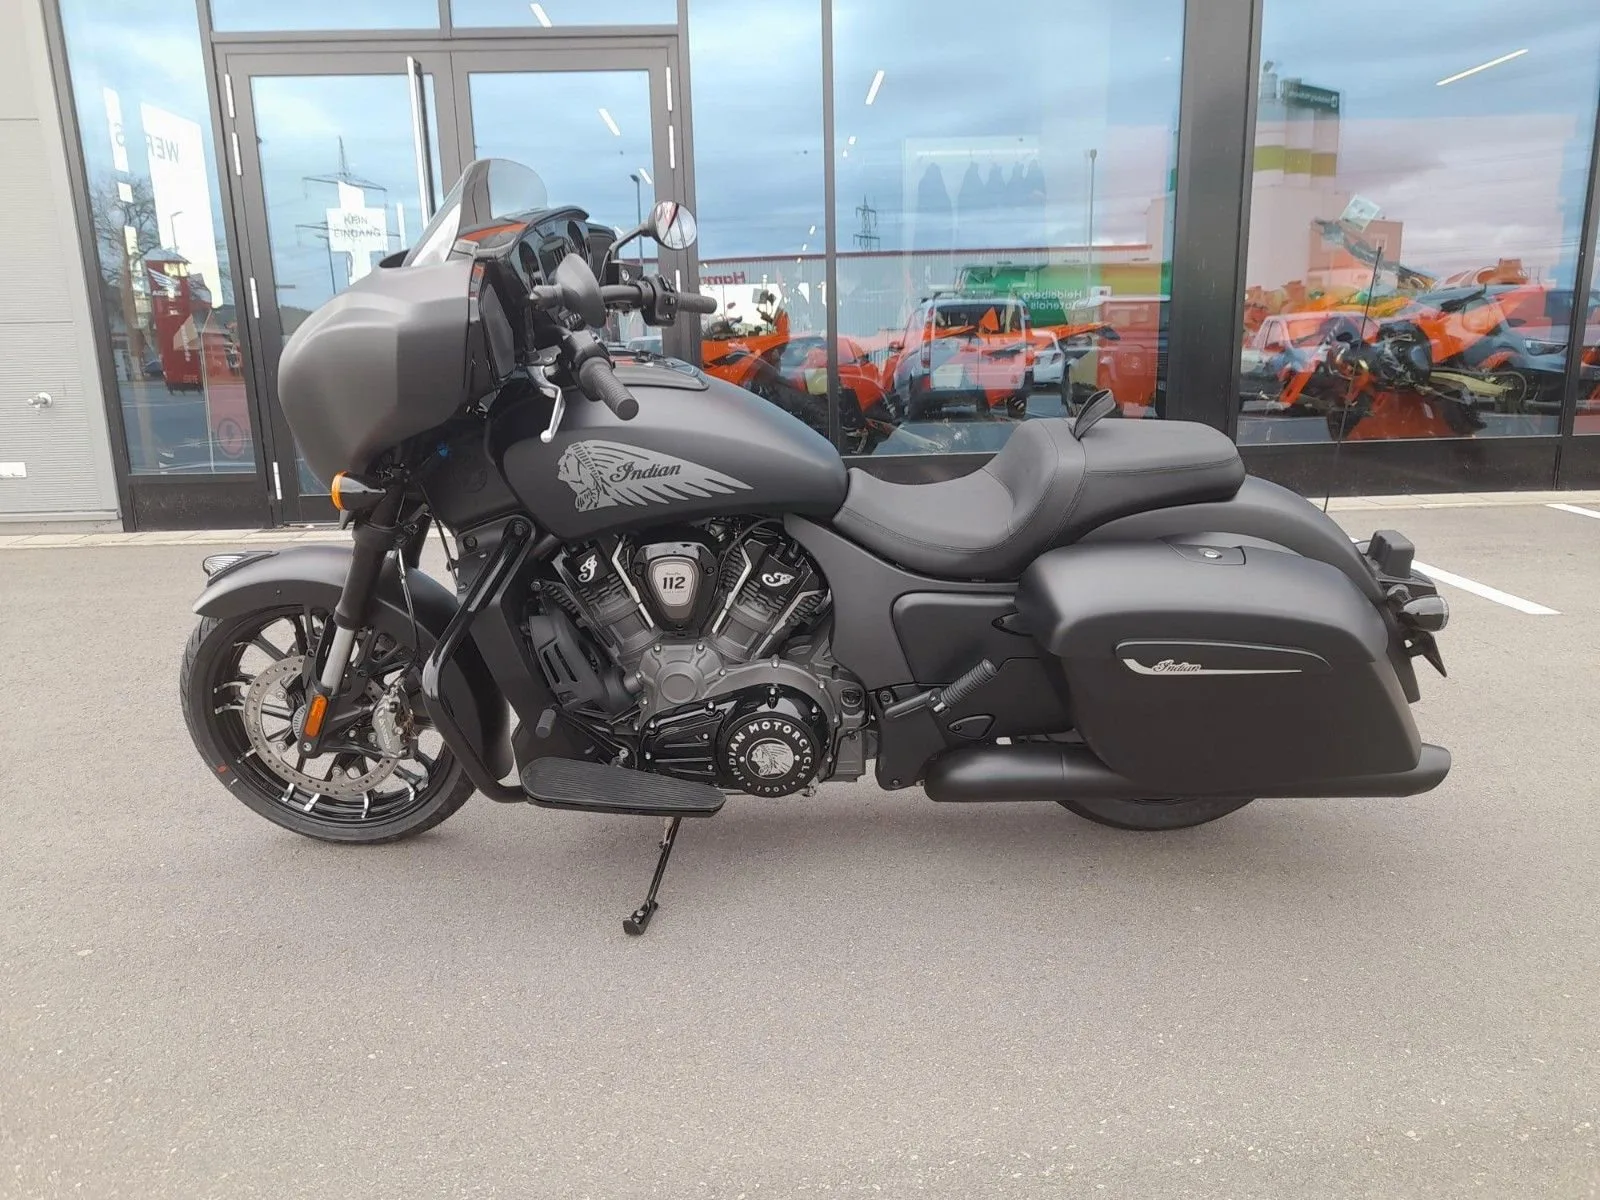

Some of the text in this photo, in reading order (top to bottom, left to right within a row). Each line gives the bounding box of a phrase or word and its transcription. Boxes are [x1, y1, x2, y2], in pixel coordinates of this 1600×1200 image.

[343, 215, 368, 225] KEIN
[609, 461, 682, 483] Indian
[662, 576, 686, 590] 112
[1152, 660, 1201, 673] Indian
[728, 721, 812, 781] INDIAN MOTORCYCLE
